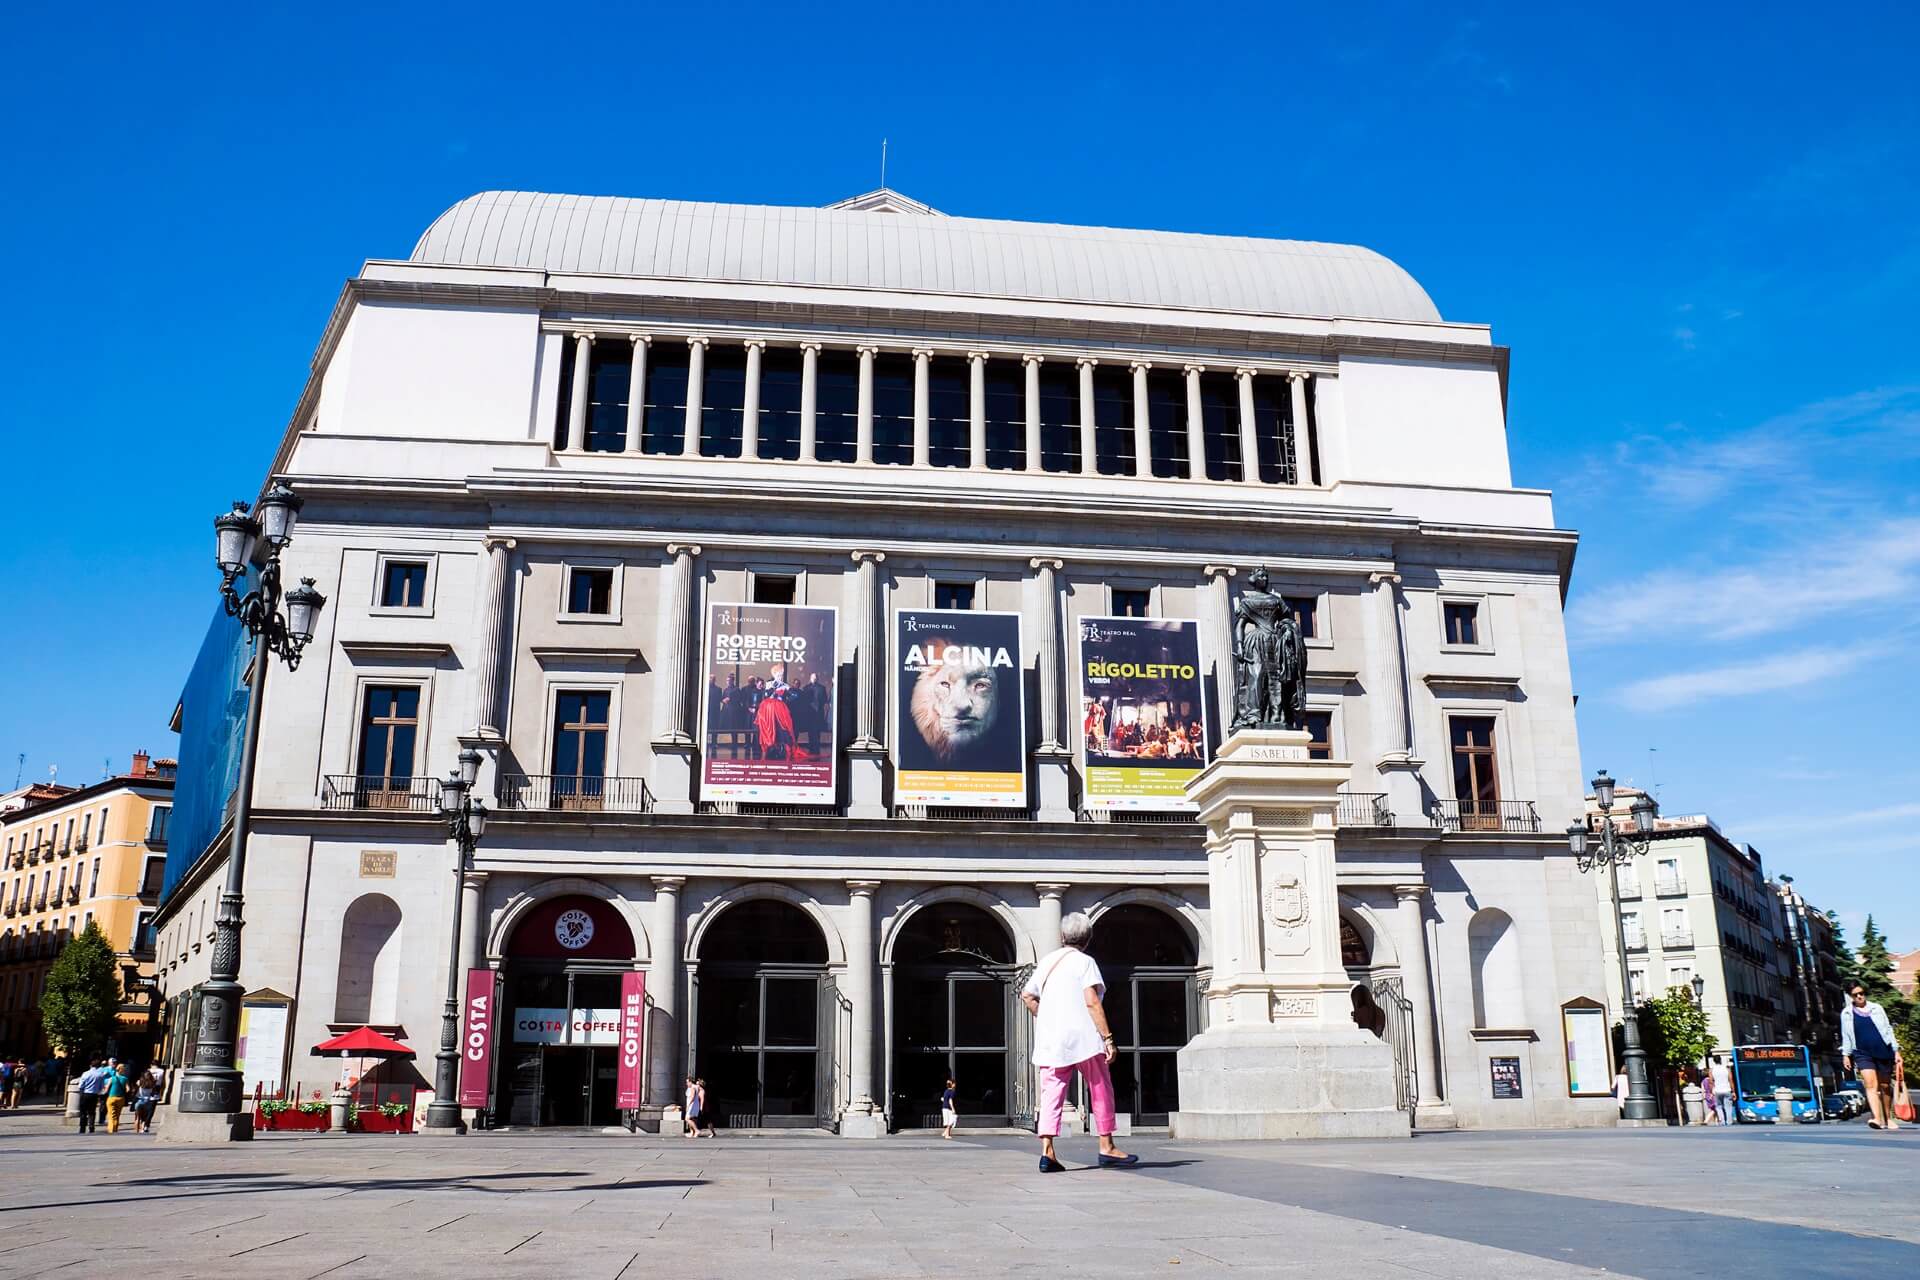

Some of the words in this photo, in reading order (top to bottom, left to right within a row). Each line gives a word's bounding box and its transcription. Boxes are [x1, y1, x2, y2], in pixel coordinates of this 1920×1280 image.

[716, 634, 807, 651] ROBERTO
[716, 648, 806, 663] DEVEREUX
[904, 644, 1014, 668] ALCINA
[1087, 662, 1195, 680] RIGOLETTO
[1251, 748, 1289, 759] ISABEL
[1292, 749, 1300, 759] II
[561, 912, 588, 923] COSTA
[559, 933, 590, 946] COFFEE
[468, 996, 488, 1061] COSTA
[519, 1021, 562, 1032] COSTA
[573, 1022, 621, 1032] COFFEE
[624, 993, 640, 1068] COFFEE
